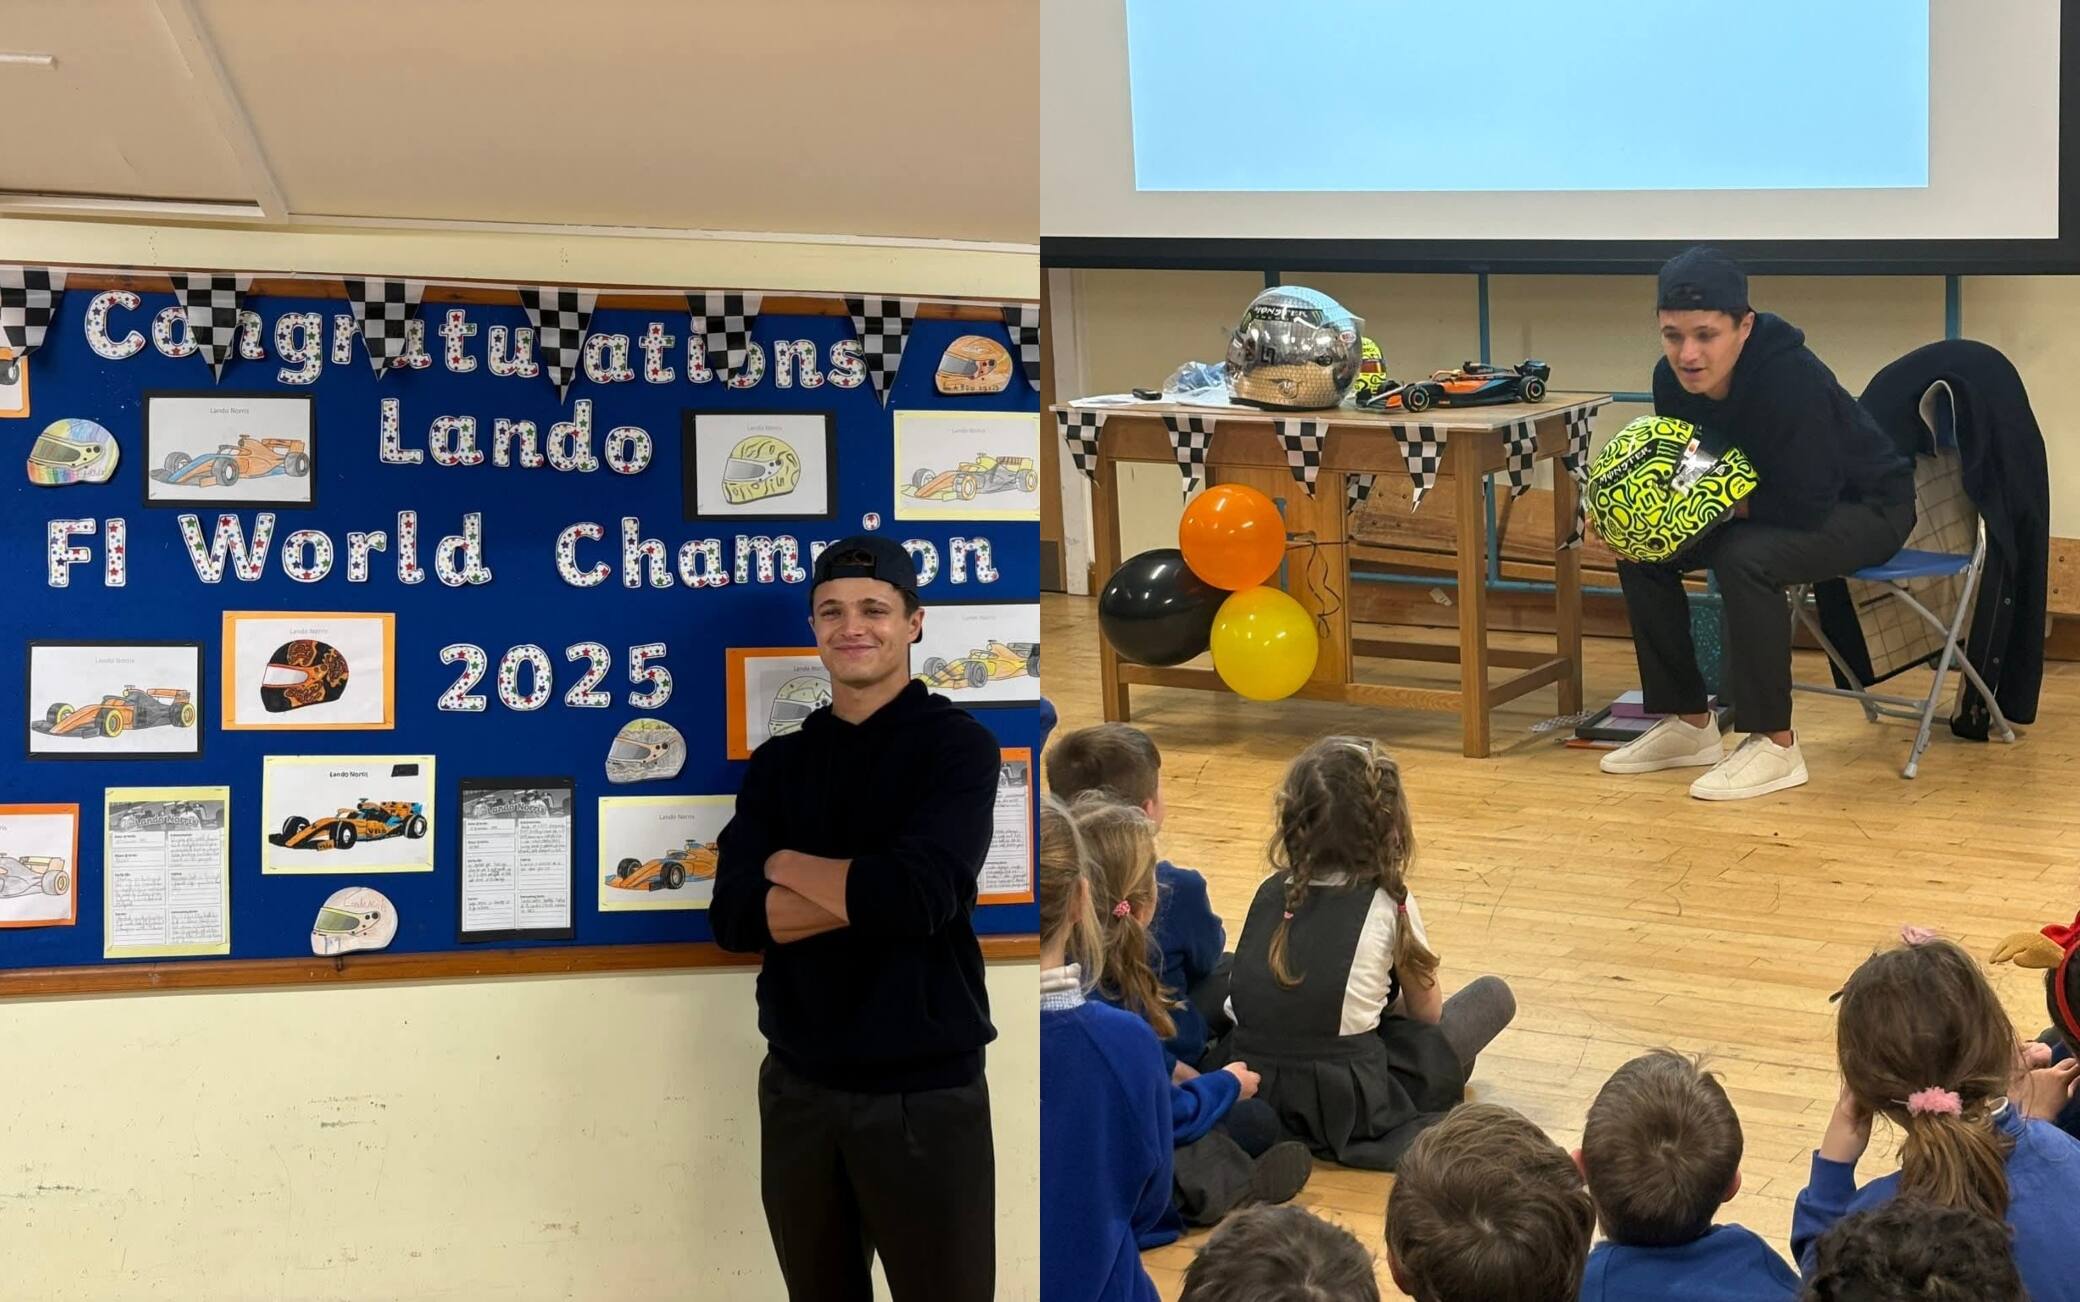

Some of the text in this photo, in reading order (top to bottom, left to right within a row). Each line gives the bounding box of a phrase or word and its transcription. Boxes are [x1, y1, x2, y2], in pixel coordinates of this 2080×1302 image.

[84, 290, 867, 388] Congrtuations
[380, 397, 652, 474] Lando
[177, 510, 492, 588] World
[556, 512, 1000, 588] Chamon
[438, 641, 674, 712] 2025
